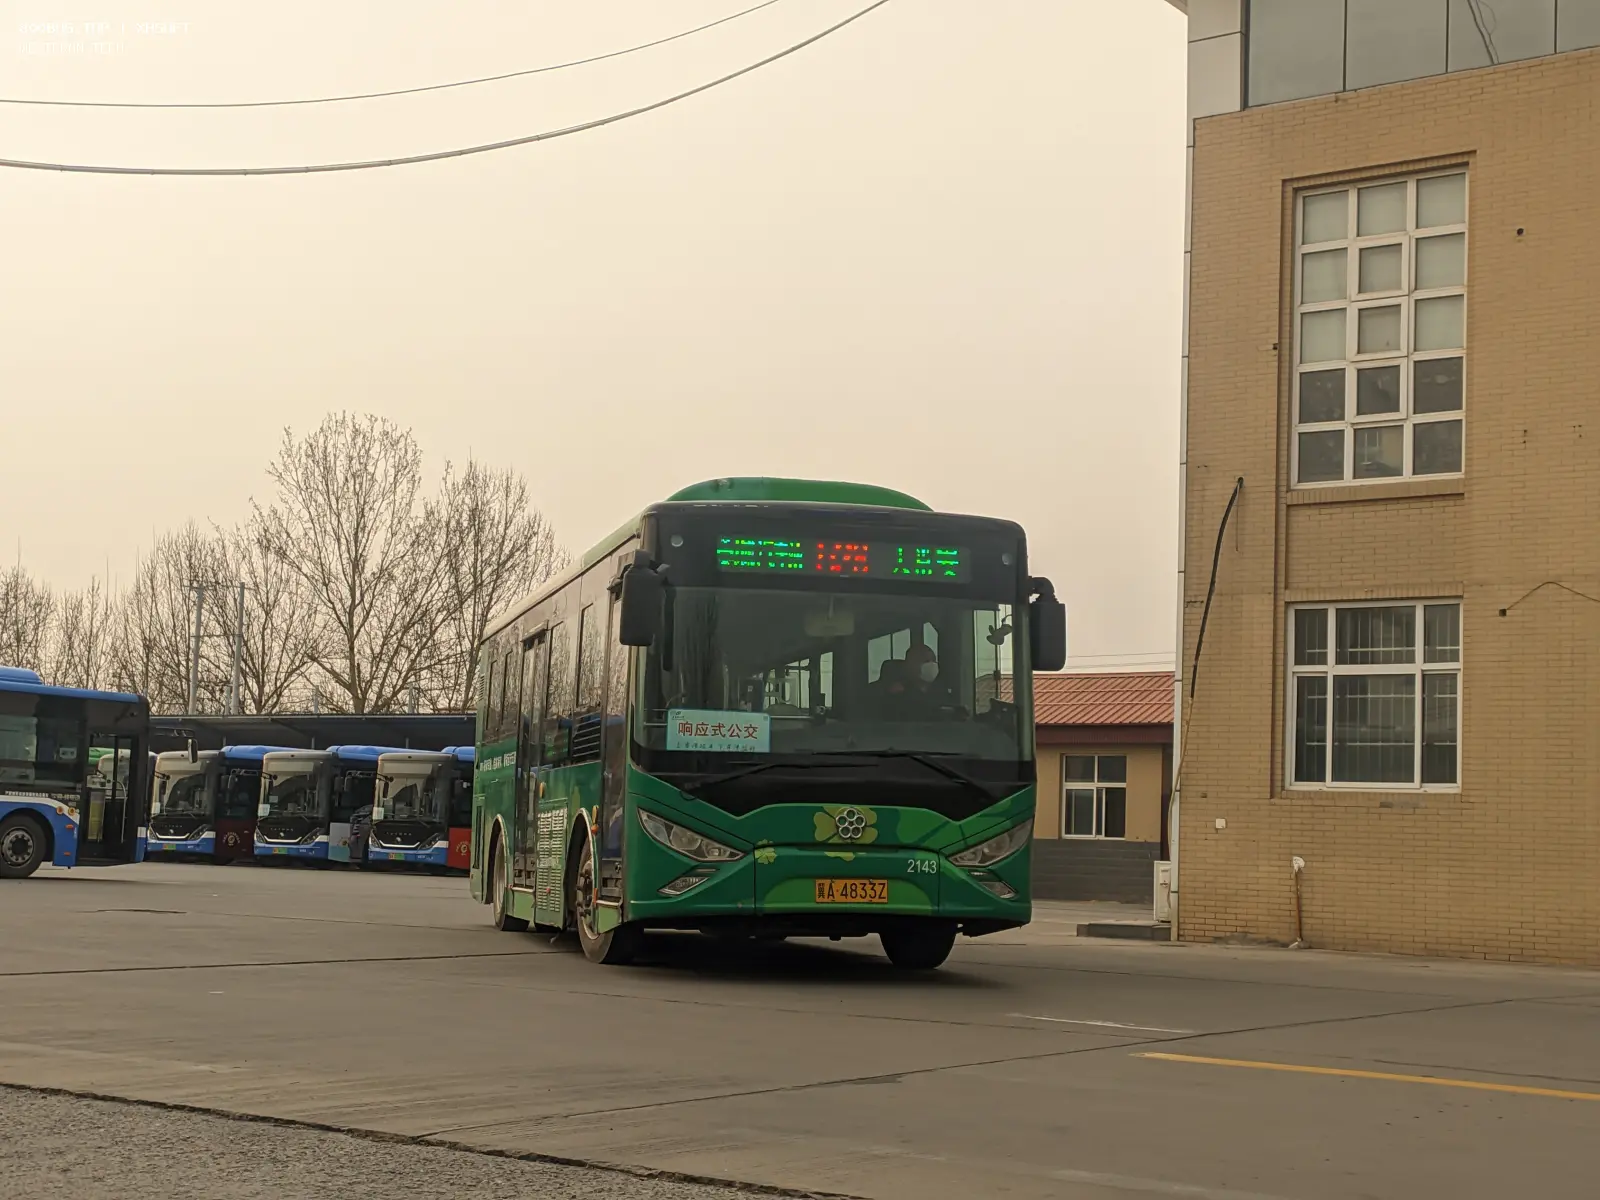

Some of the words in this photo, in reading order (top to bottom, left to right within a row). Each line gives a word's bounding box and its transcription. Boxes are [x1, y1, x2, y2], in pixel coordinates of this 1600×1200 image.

[677, 721, 759, 740] 响应式公交
[906, 859, 938, 874] 2143
